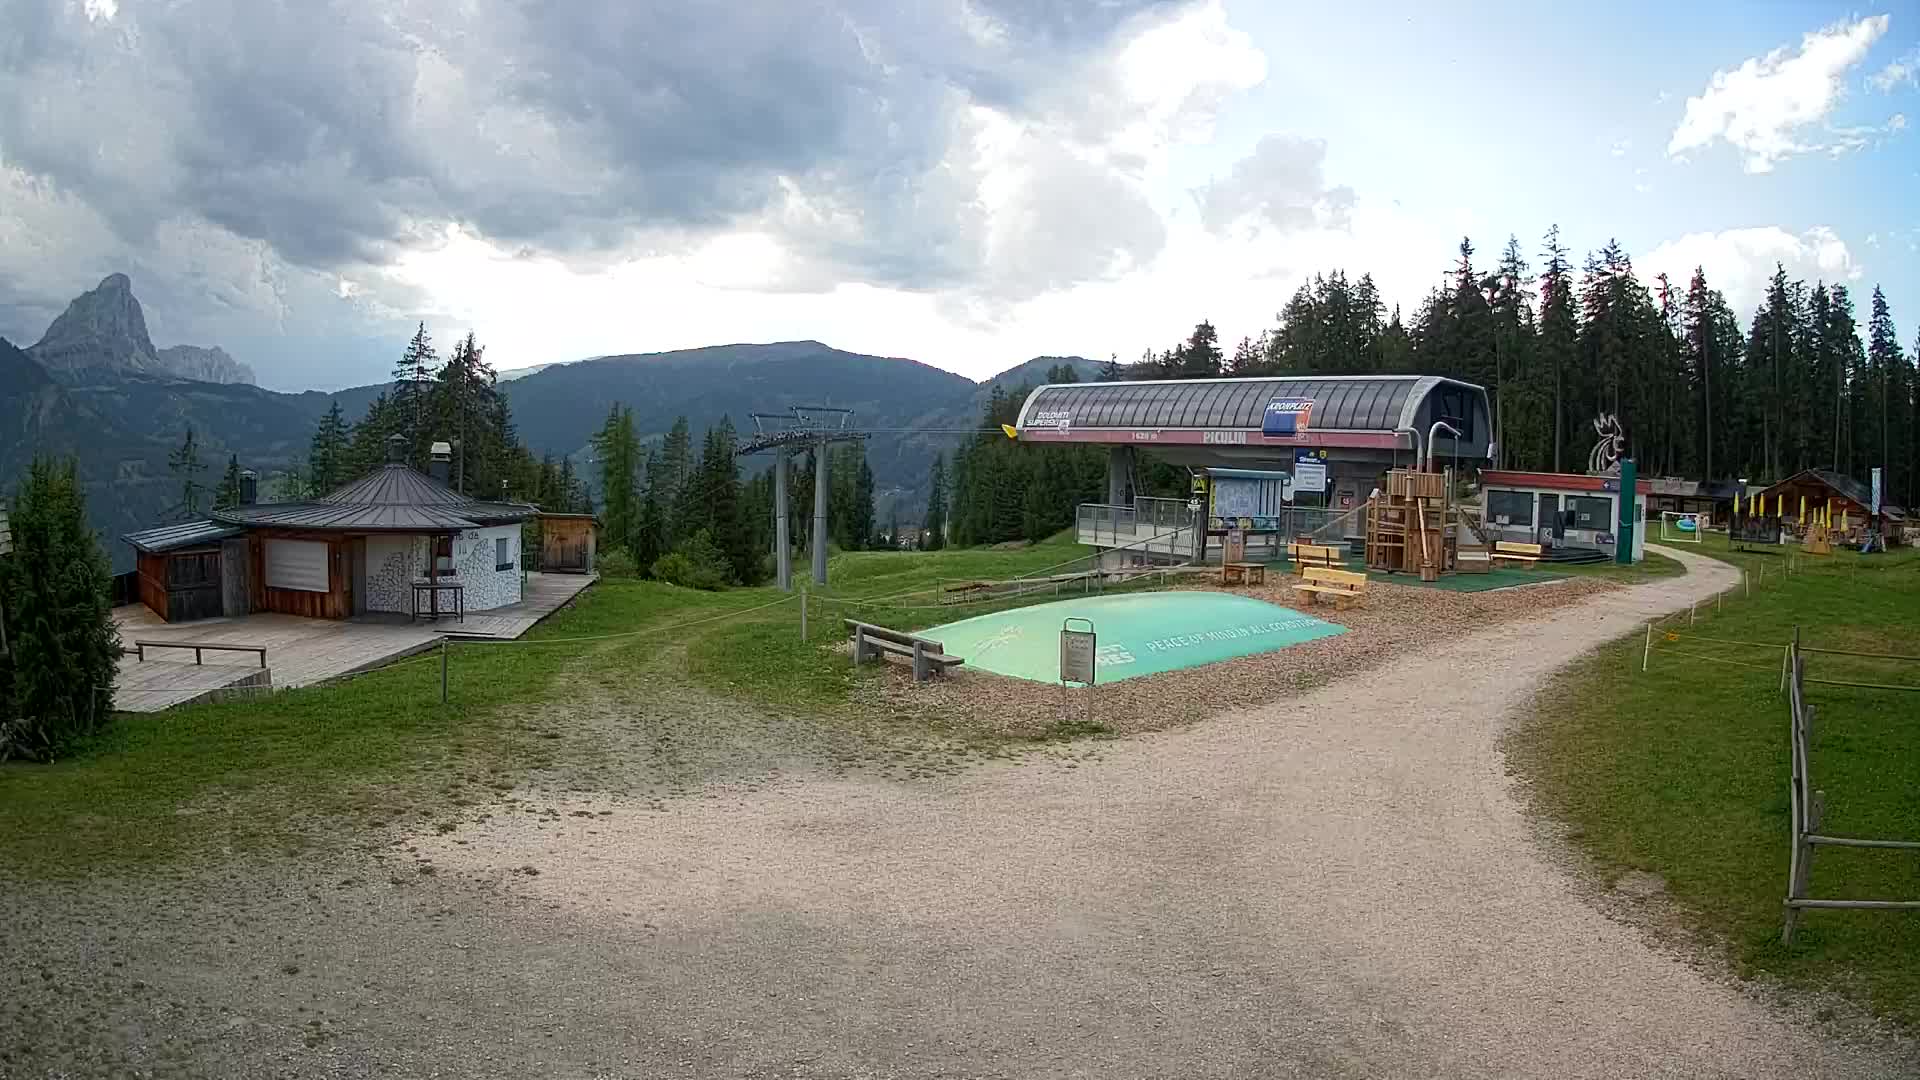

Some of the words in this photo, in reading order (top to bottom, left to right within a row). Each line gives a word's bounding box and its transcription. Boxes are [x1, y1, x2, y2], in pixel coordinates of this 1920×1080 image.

[1203, 431, 1247, 444] PICULIN
[1146, 635, 1189, 652] PEACE
[1188, 633, 1204, 645] OF
[1206, 630, 1237, 641] MIND
[1249, 623, 1271, 635] ALL
